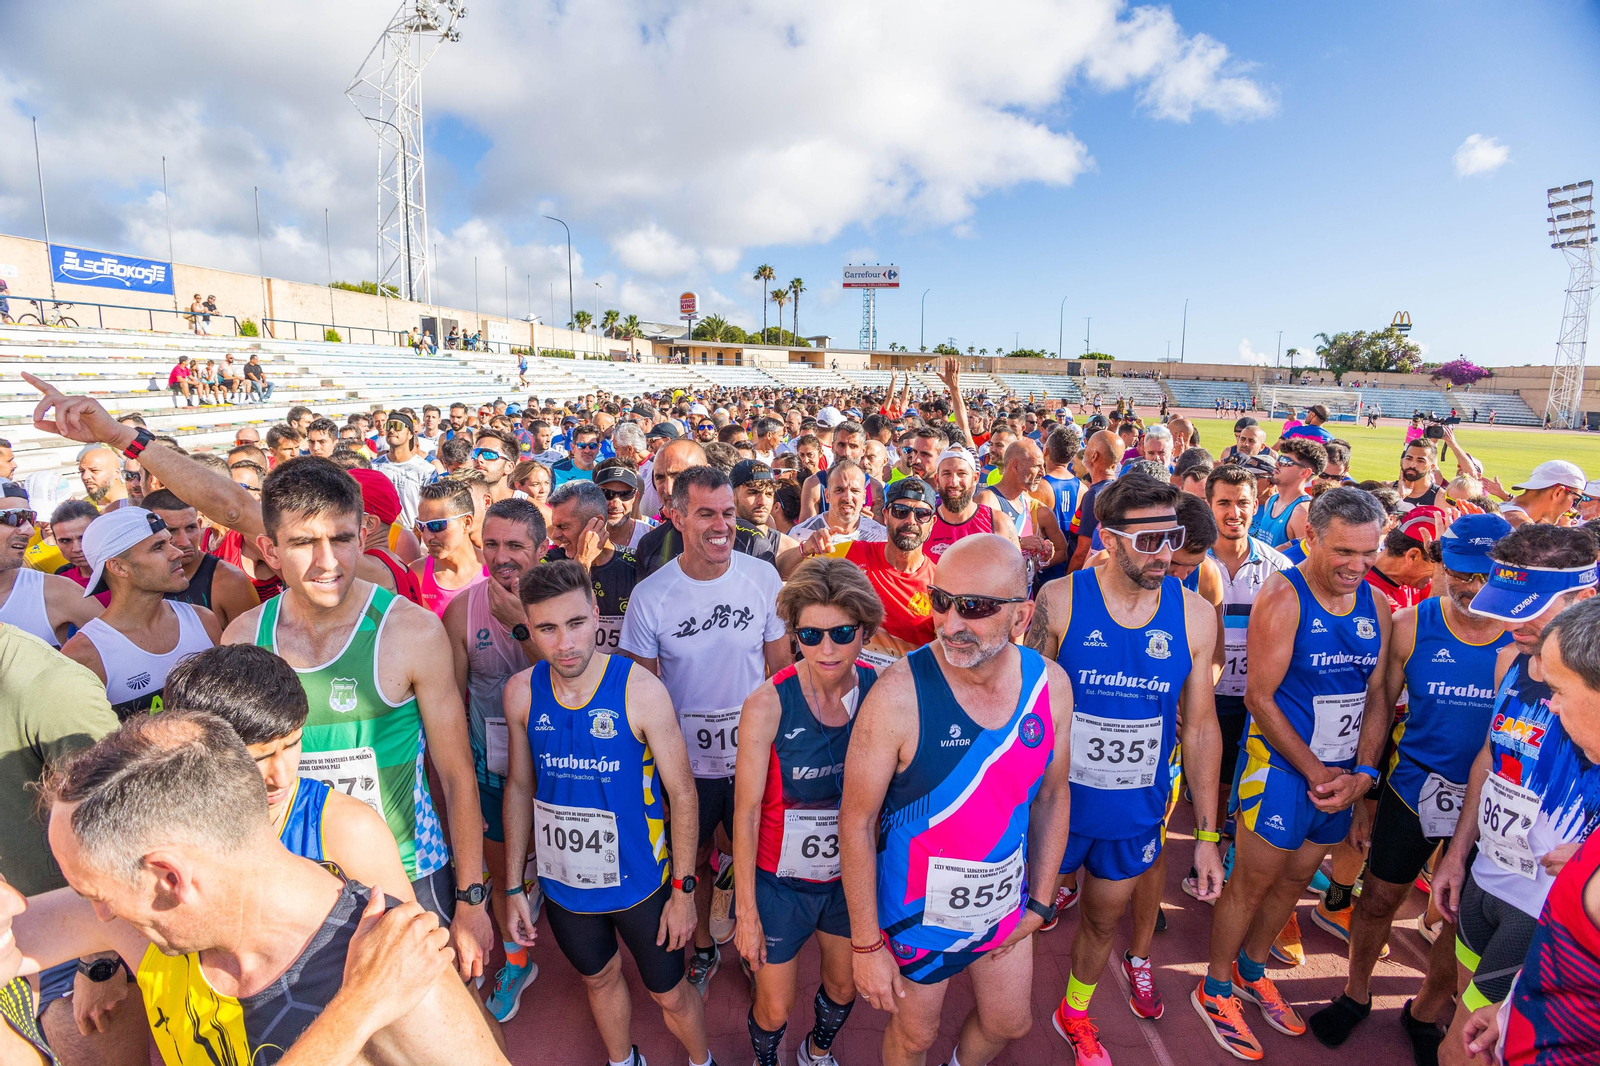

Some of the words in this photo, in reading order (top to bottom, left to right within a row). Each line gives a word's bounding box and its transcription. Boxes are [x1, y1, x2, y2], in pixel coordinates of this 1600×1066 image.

[64, 251, 166, 285] ELECTROKOSTE
[844, 270, 881, 279] Carrefour
[680, 302, 696, 310] KING
[1078, 669, 1171, 693] Tirabuzón
[1097, 689, 1115, 697] Piedra
[1115, 690, 1139, 699] Pikachos
[940, 738, 971, 748] VIATOR
[1086, 737, 1146, 764] 335
[1483, 796, 1520, 838] 967
[542, 823, 603, 854] 1094
[801, 834, 840, 859] 63
[948, 874, 1014, 910] 855
